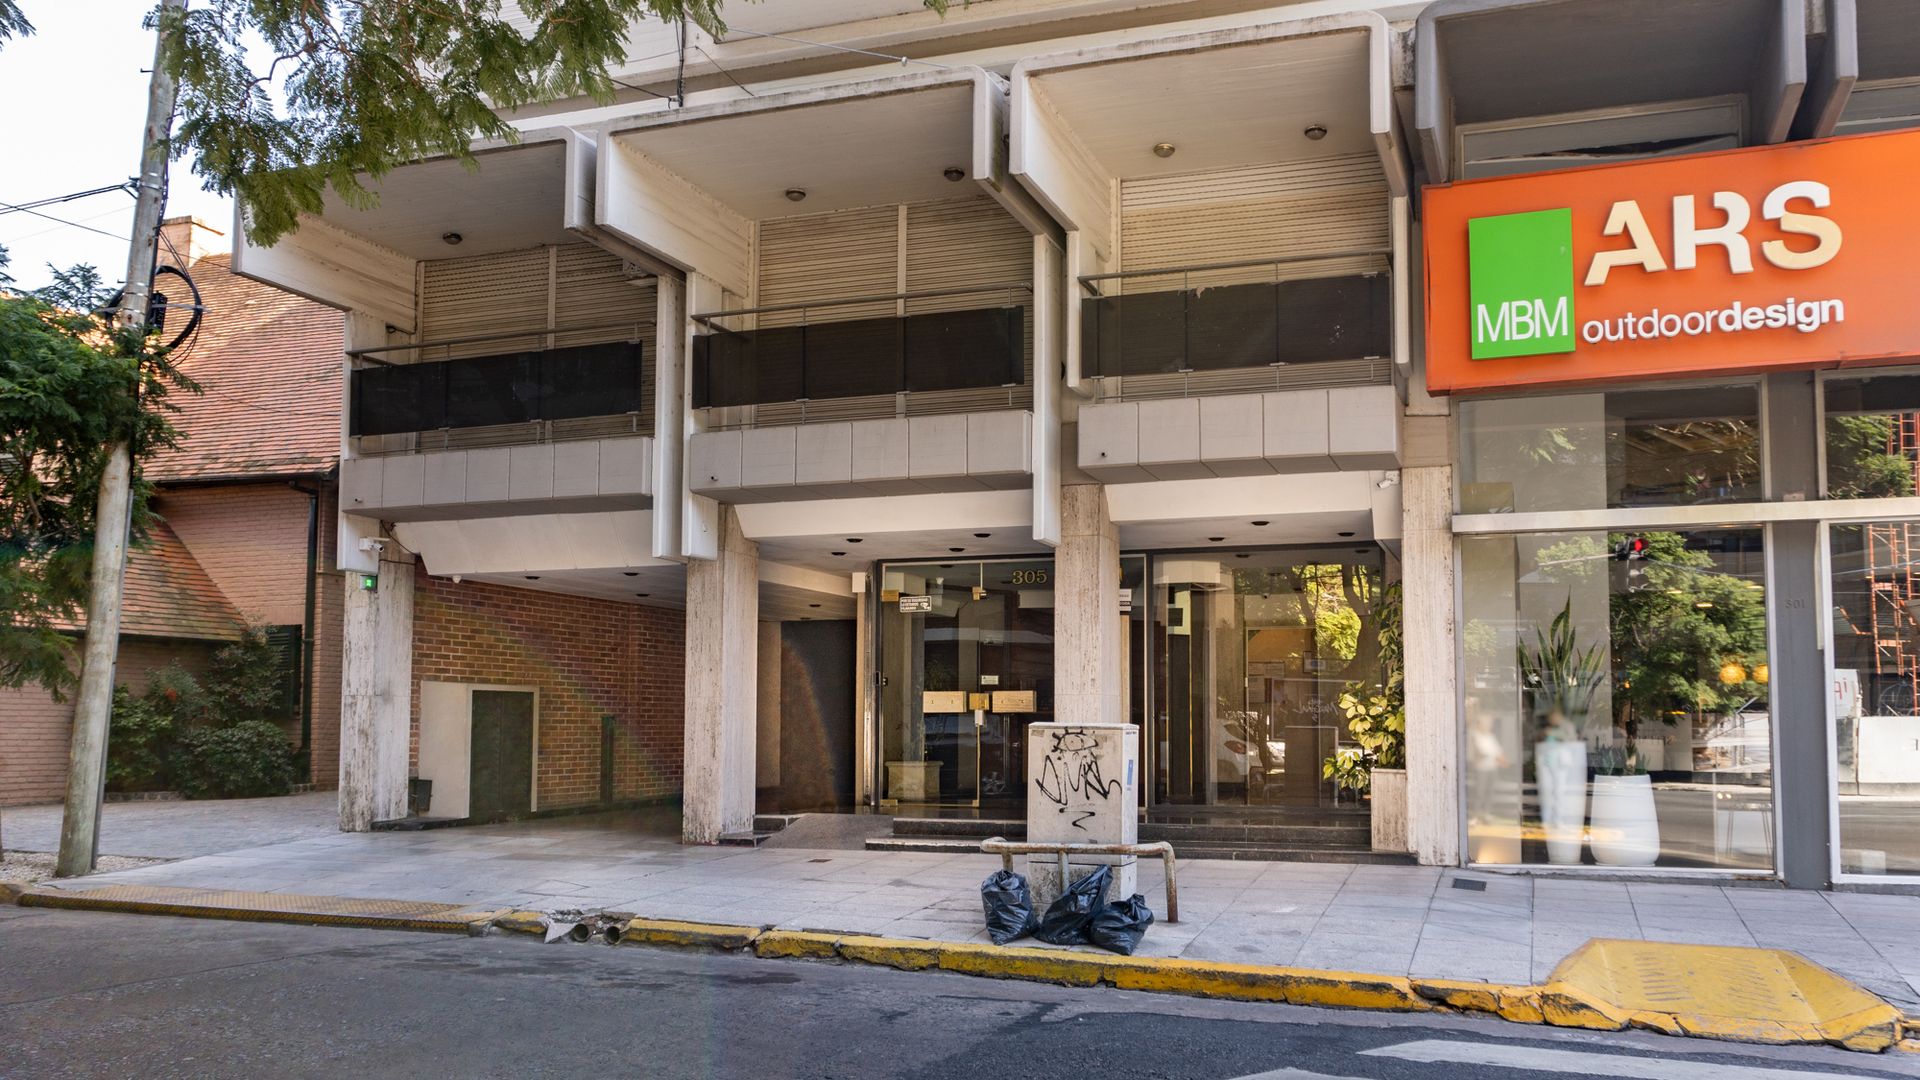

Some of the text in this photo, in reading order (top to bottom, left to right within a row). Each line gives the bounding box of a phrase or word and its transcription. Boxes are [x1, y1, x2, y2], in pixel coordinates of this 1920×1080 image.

[1584, 181, 1843, 286] ARS
[1477, 296, 1568, 344] MBM
[1582, 297, 1845, 344] outdoordesign
[1012, 570, 1048, 585] 305
